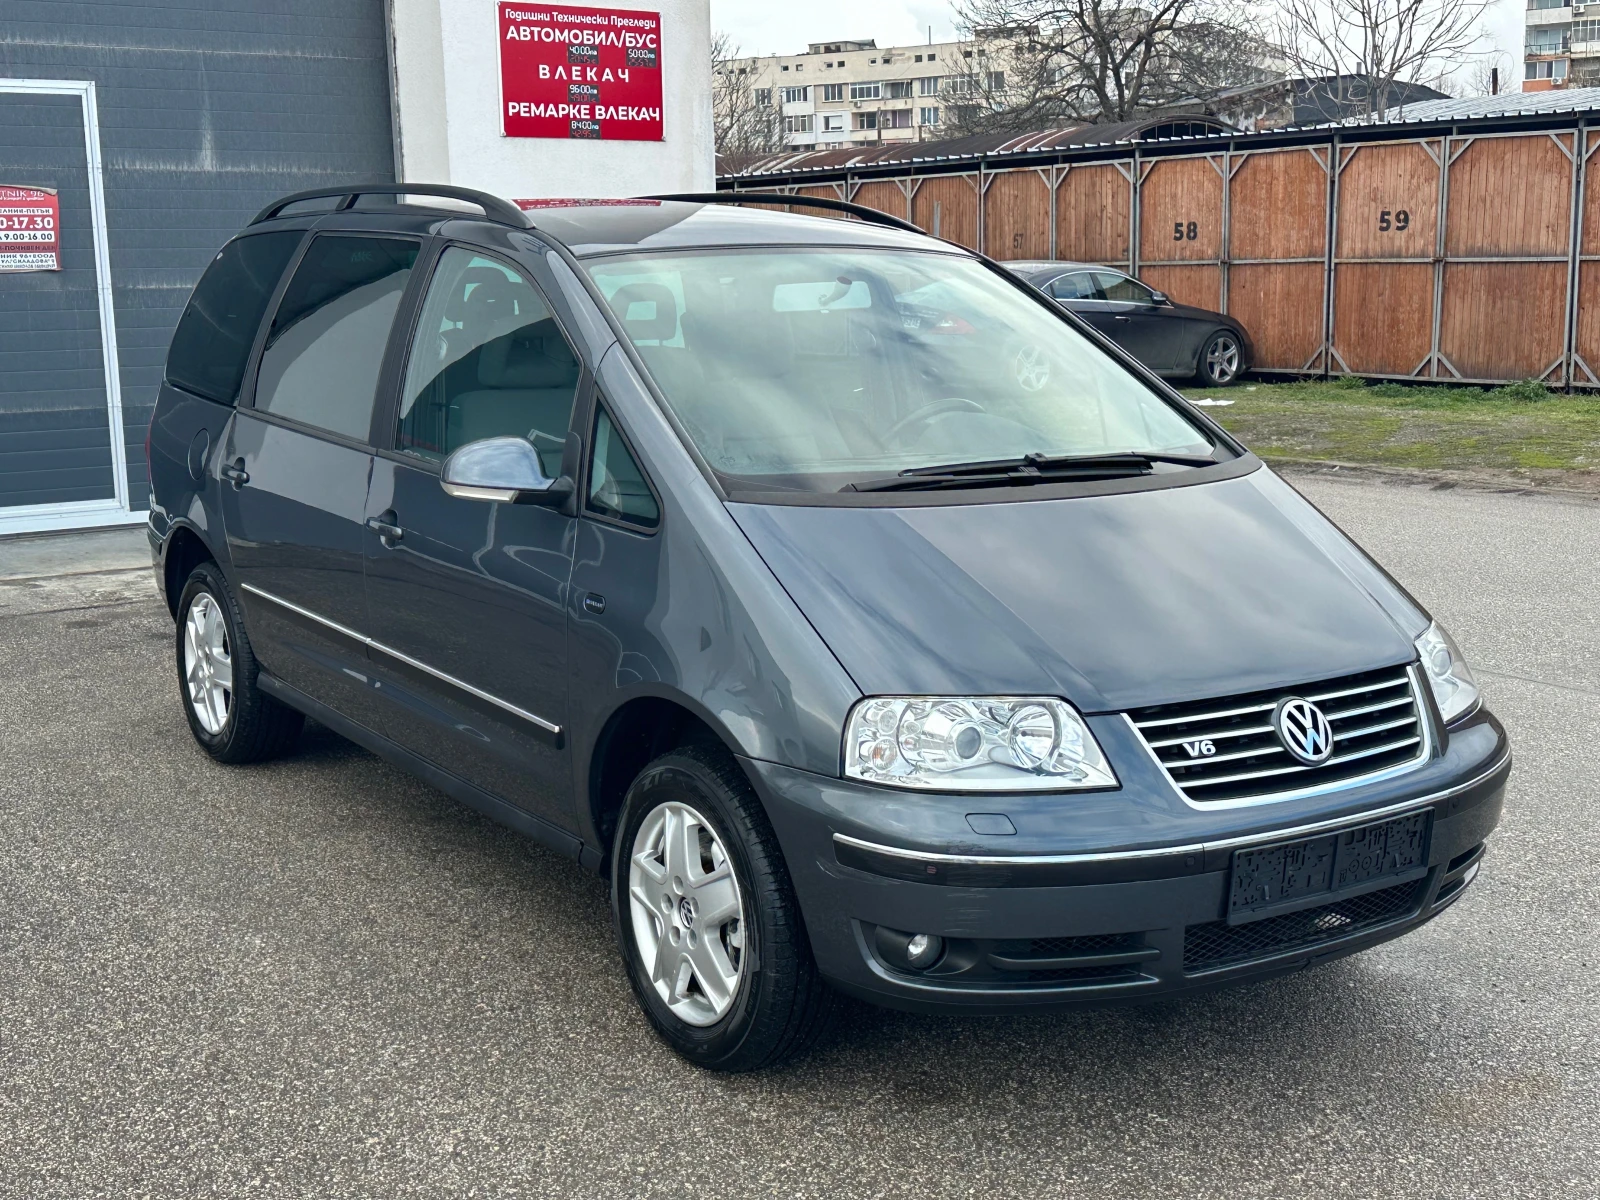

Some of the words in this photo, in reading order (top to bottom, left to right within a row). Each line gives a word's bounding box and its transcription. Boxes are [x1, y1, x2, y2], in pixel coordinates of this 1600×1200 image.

[505, 8, 550, 21] Годишни
[552, 11, 608, 25] Технически
[610, 15, 656, 30] Прегледи
[506, 25, 657, 48] АВТОМОБИЛ/БУС
[538, 64, 630, 83] ВЛЕКАЧ
[508, 102, 590, 119] РЕМАРКЕ
[595, 105, 660, 121] ВЛЕКАЧ
[1378, 210, 1409, 231] 59
[1173, 221, 1198, 241] 58
[1013, 233, 1024, 249] 57
[1182, 740, 1216, 757] V6
